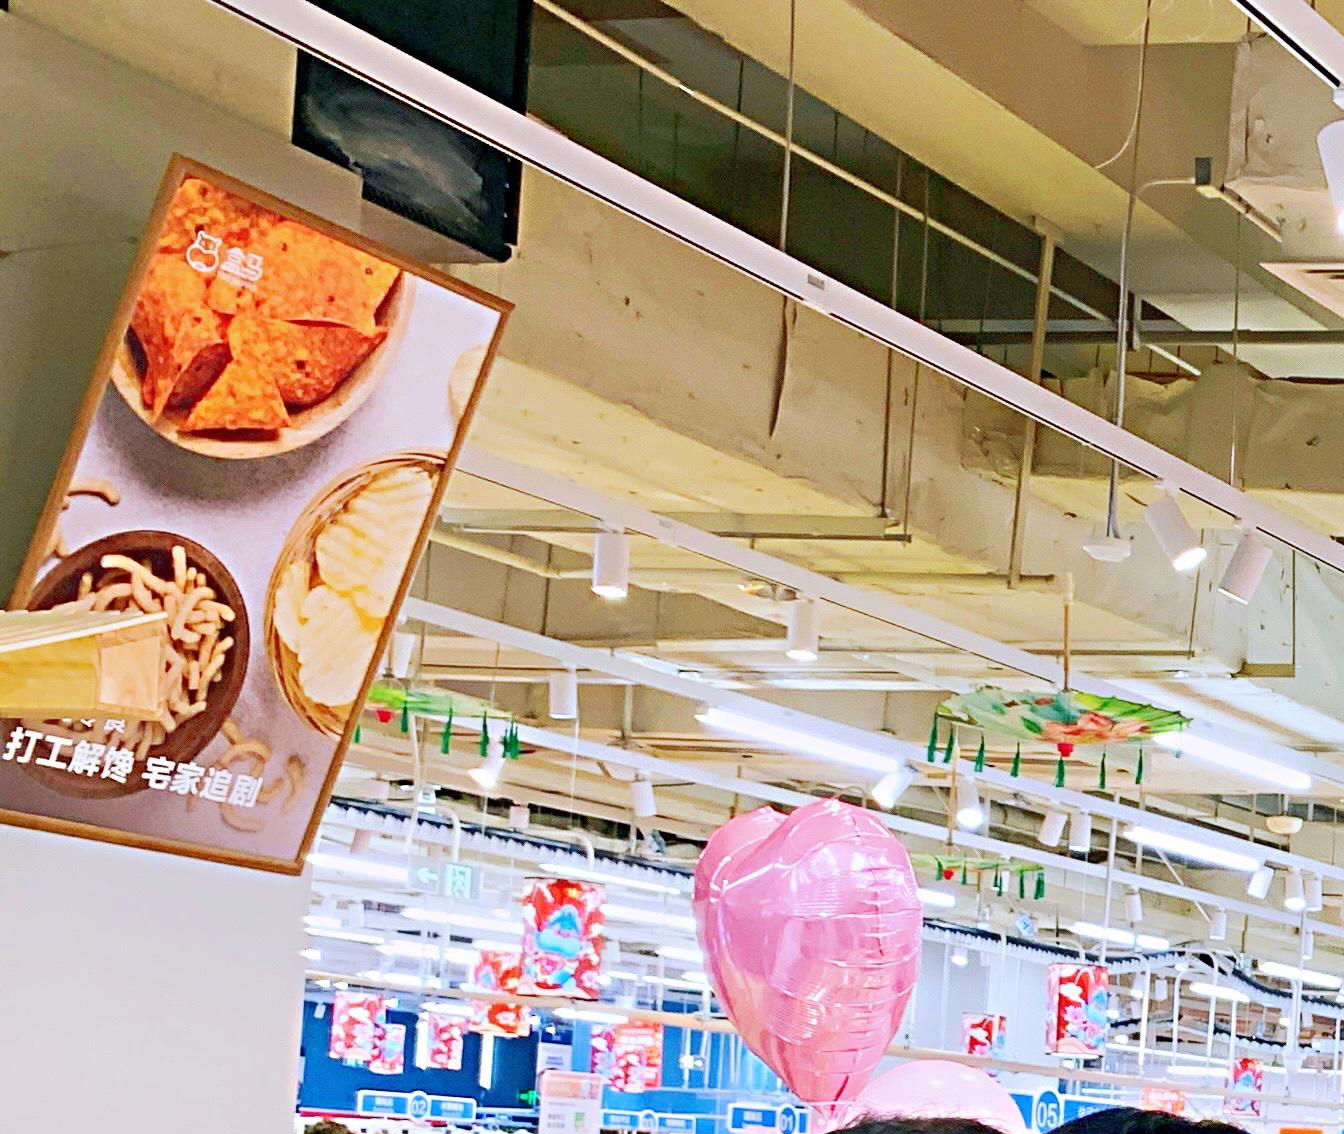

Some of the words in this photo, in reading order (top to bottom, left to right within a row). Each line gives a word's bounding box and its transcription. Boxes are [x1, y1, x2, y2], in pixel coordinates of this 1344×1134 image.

[2, 726, 136, 784] 打工解馋
[142, 756, 263, 808] 宅家追剧
[1037, 1101, 1058, 1127] 05
